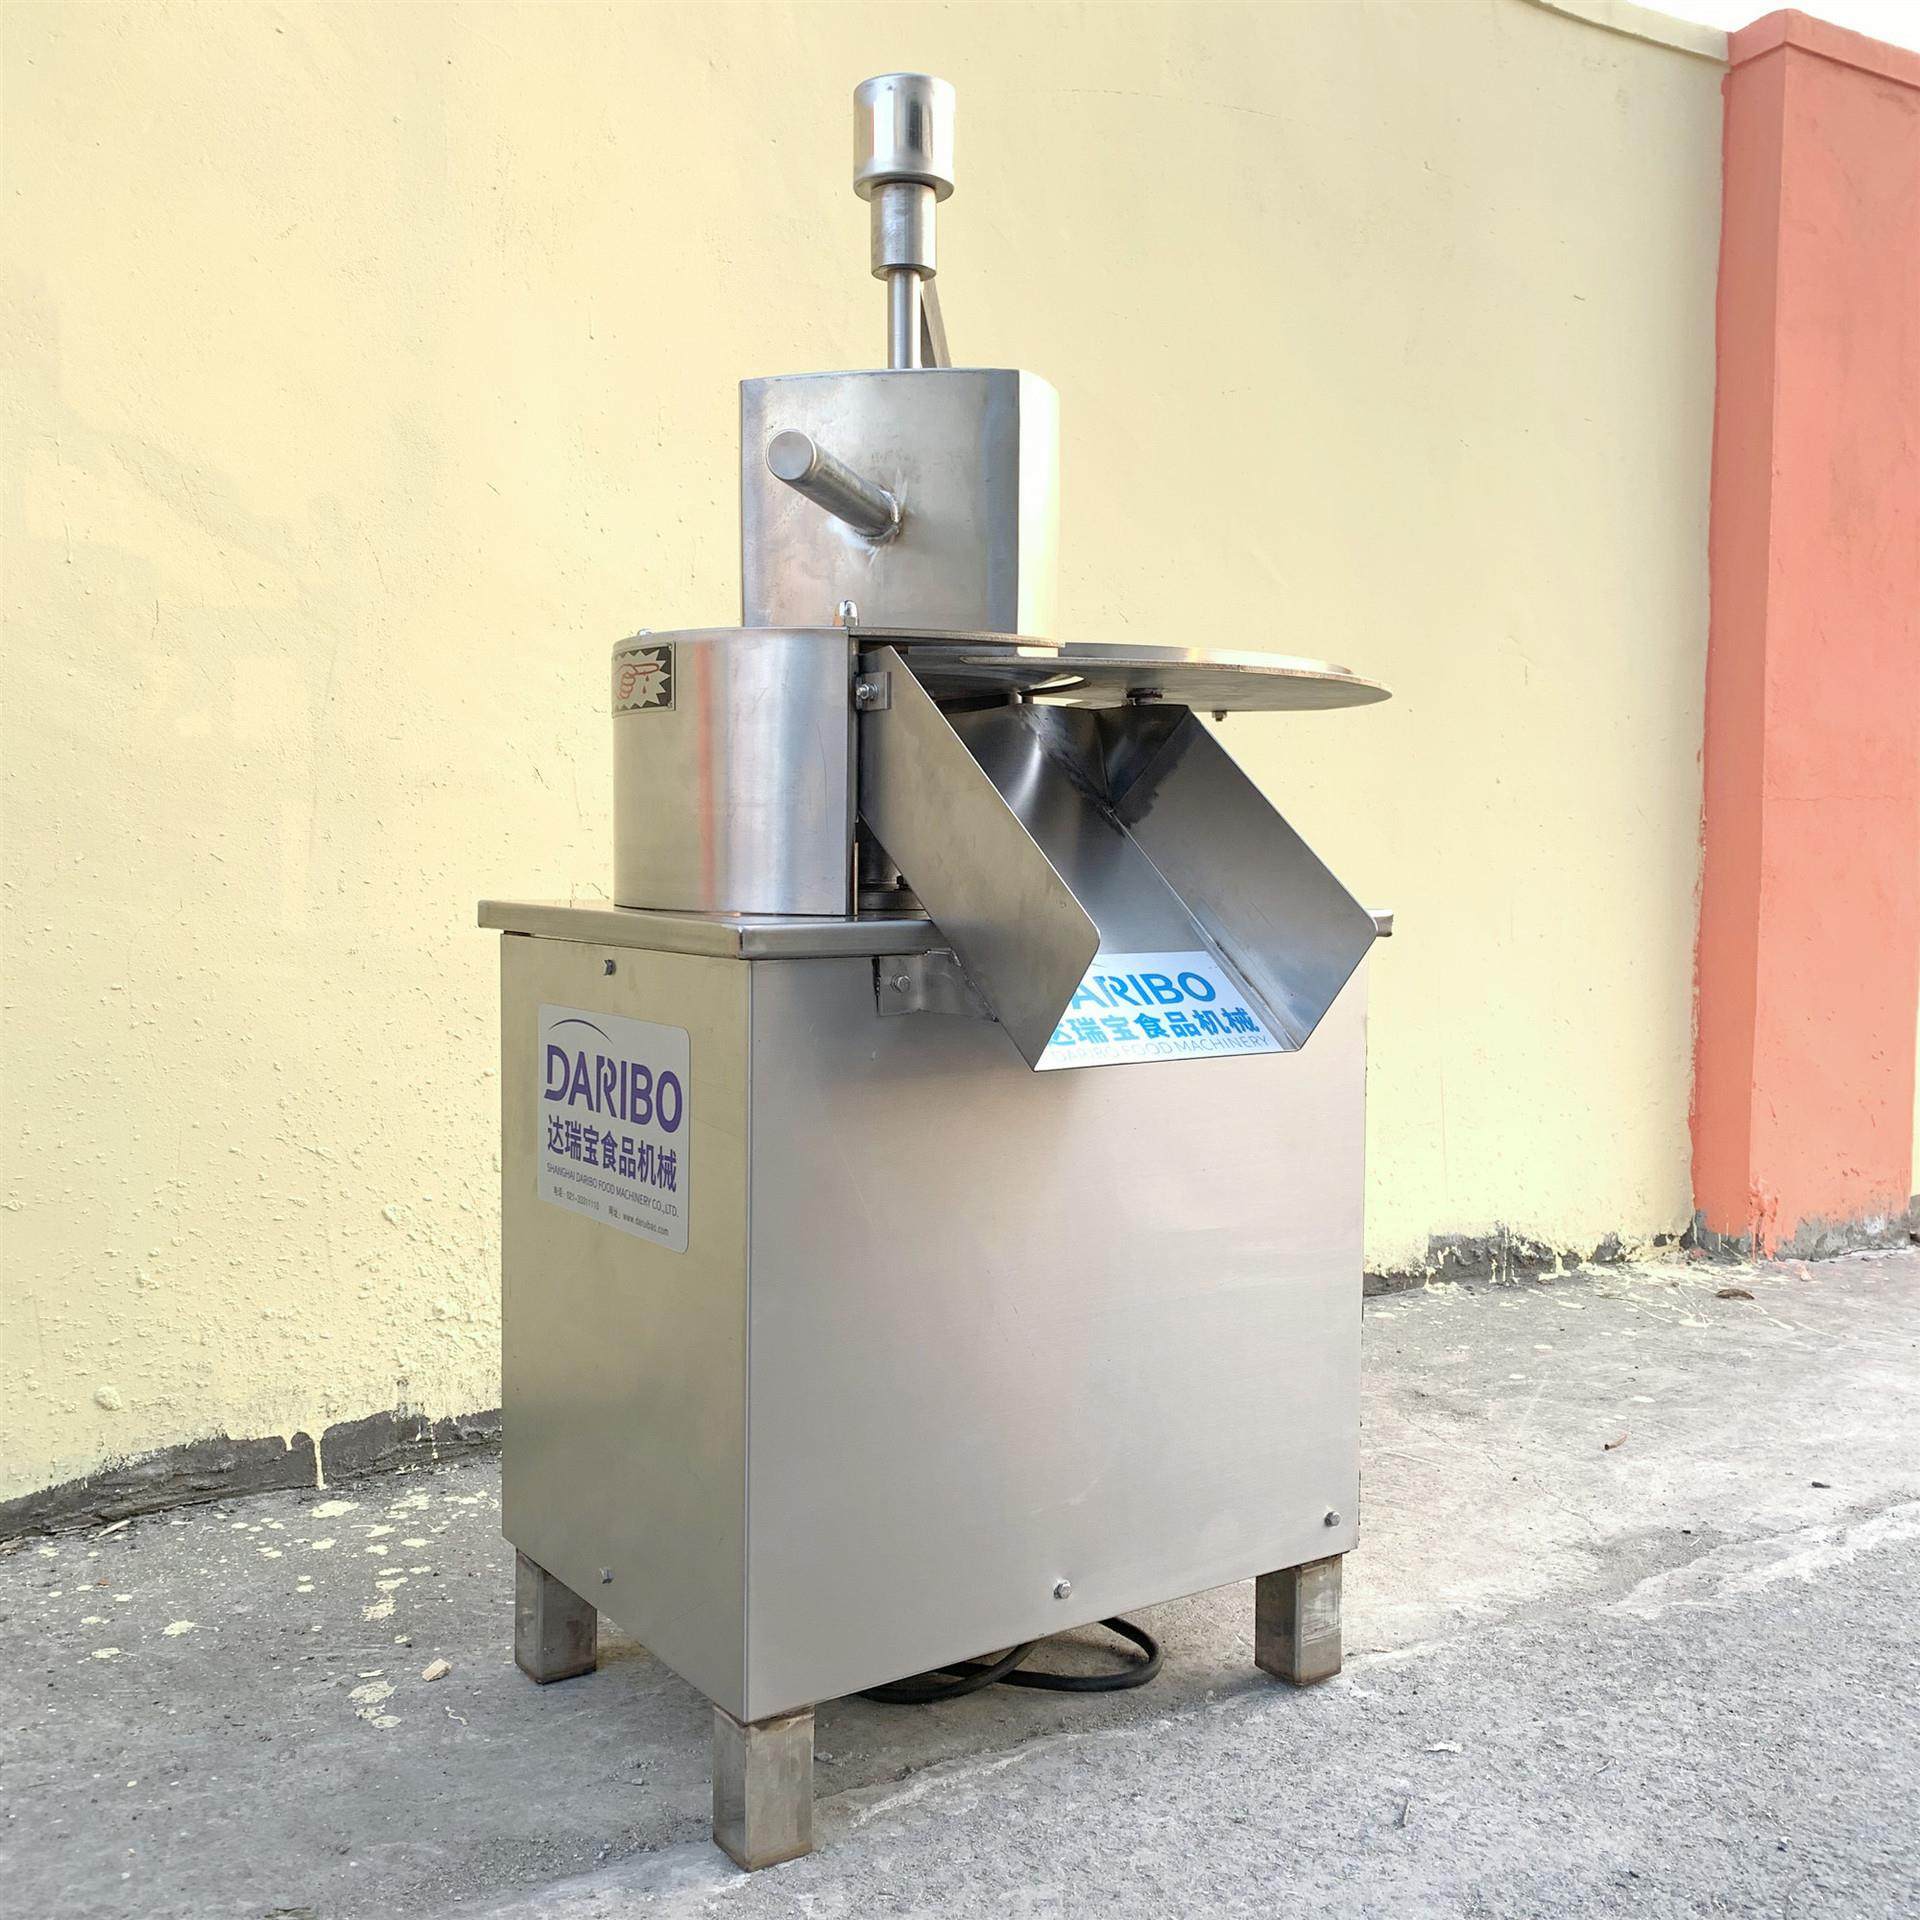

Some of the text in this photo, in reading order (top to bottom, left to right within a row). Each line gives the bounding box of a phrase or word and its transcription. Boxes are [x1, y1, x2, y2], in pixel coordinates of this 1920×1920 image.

[1071, 972, 1216, 1009] ARIBO
[1174, 1035, 1270, 1053] MACHINERY
[544, 1044, 683, 1133] DARIBO
[548, 1114, 677, 1192] 达瑞宝食品机械
[547, 1162, 576, 1182] SHANGHAI
[598, 1179, 615, 1195] FOOD
[616, 1186, 651, 1208] MACHINERY
